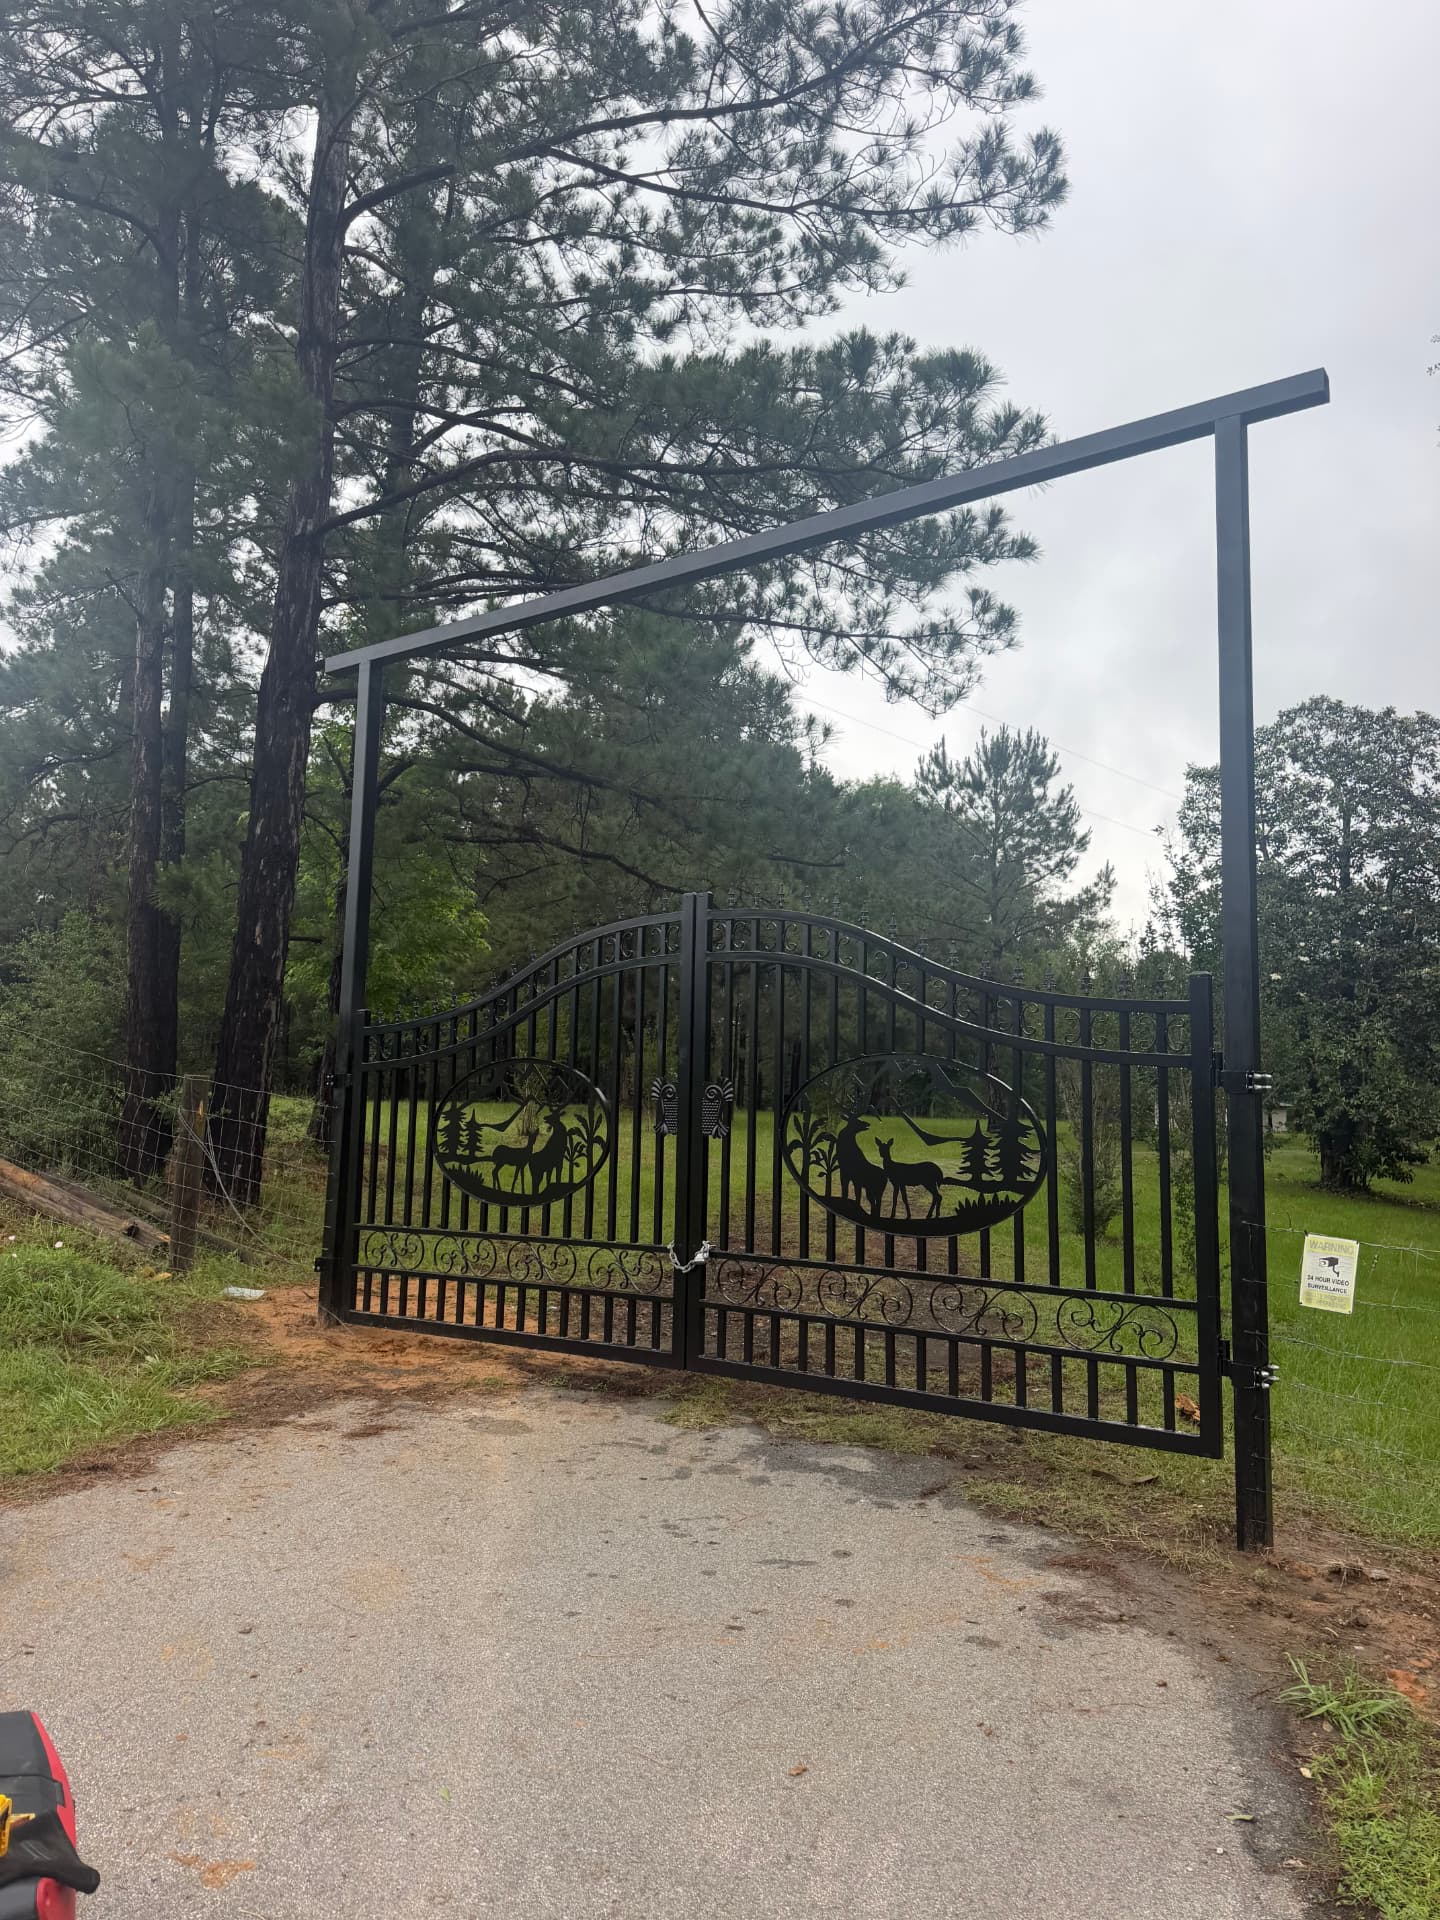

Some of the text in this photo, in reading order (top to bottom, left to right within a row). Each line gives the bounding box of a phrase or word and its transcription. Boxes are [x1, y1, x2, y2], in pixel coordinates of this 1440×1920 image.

[1310, 1240, 1354, 1254] WARNING
[1307, 1282, 1347, 1294] SURVEILLANCE
[1332, 1278, 1350, 1287] VIDEO
